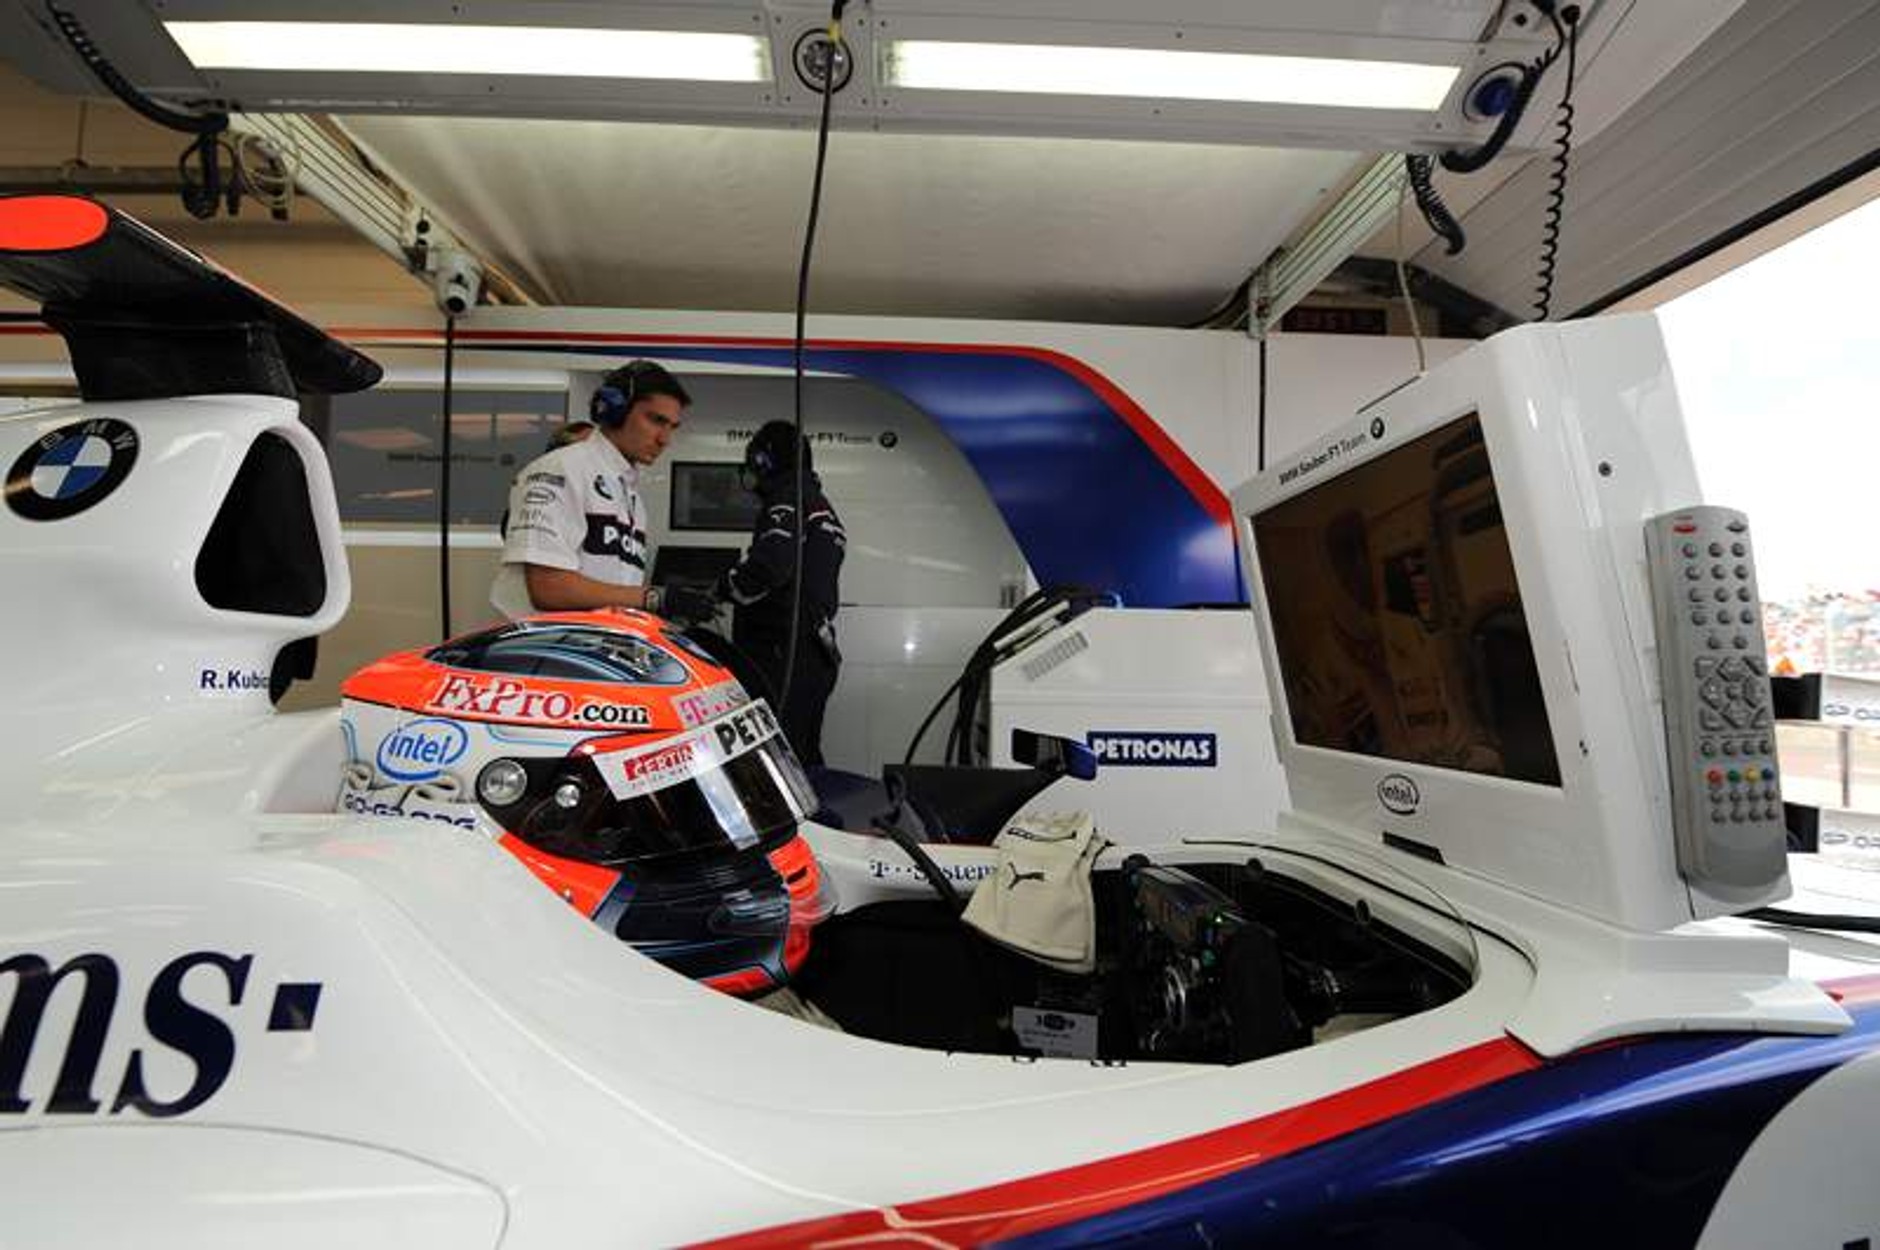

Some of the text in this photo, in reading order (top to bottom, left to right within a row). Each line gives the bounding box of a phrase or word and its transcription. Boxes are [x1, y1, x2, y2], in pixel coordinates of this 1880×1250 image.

[431, 675, 649, 725] FxPro.com
[387, 733, 452, 764] intel
[1093, 738, 1211, 760] PETRONAS
